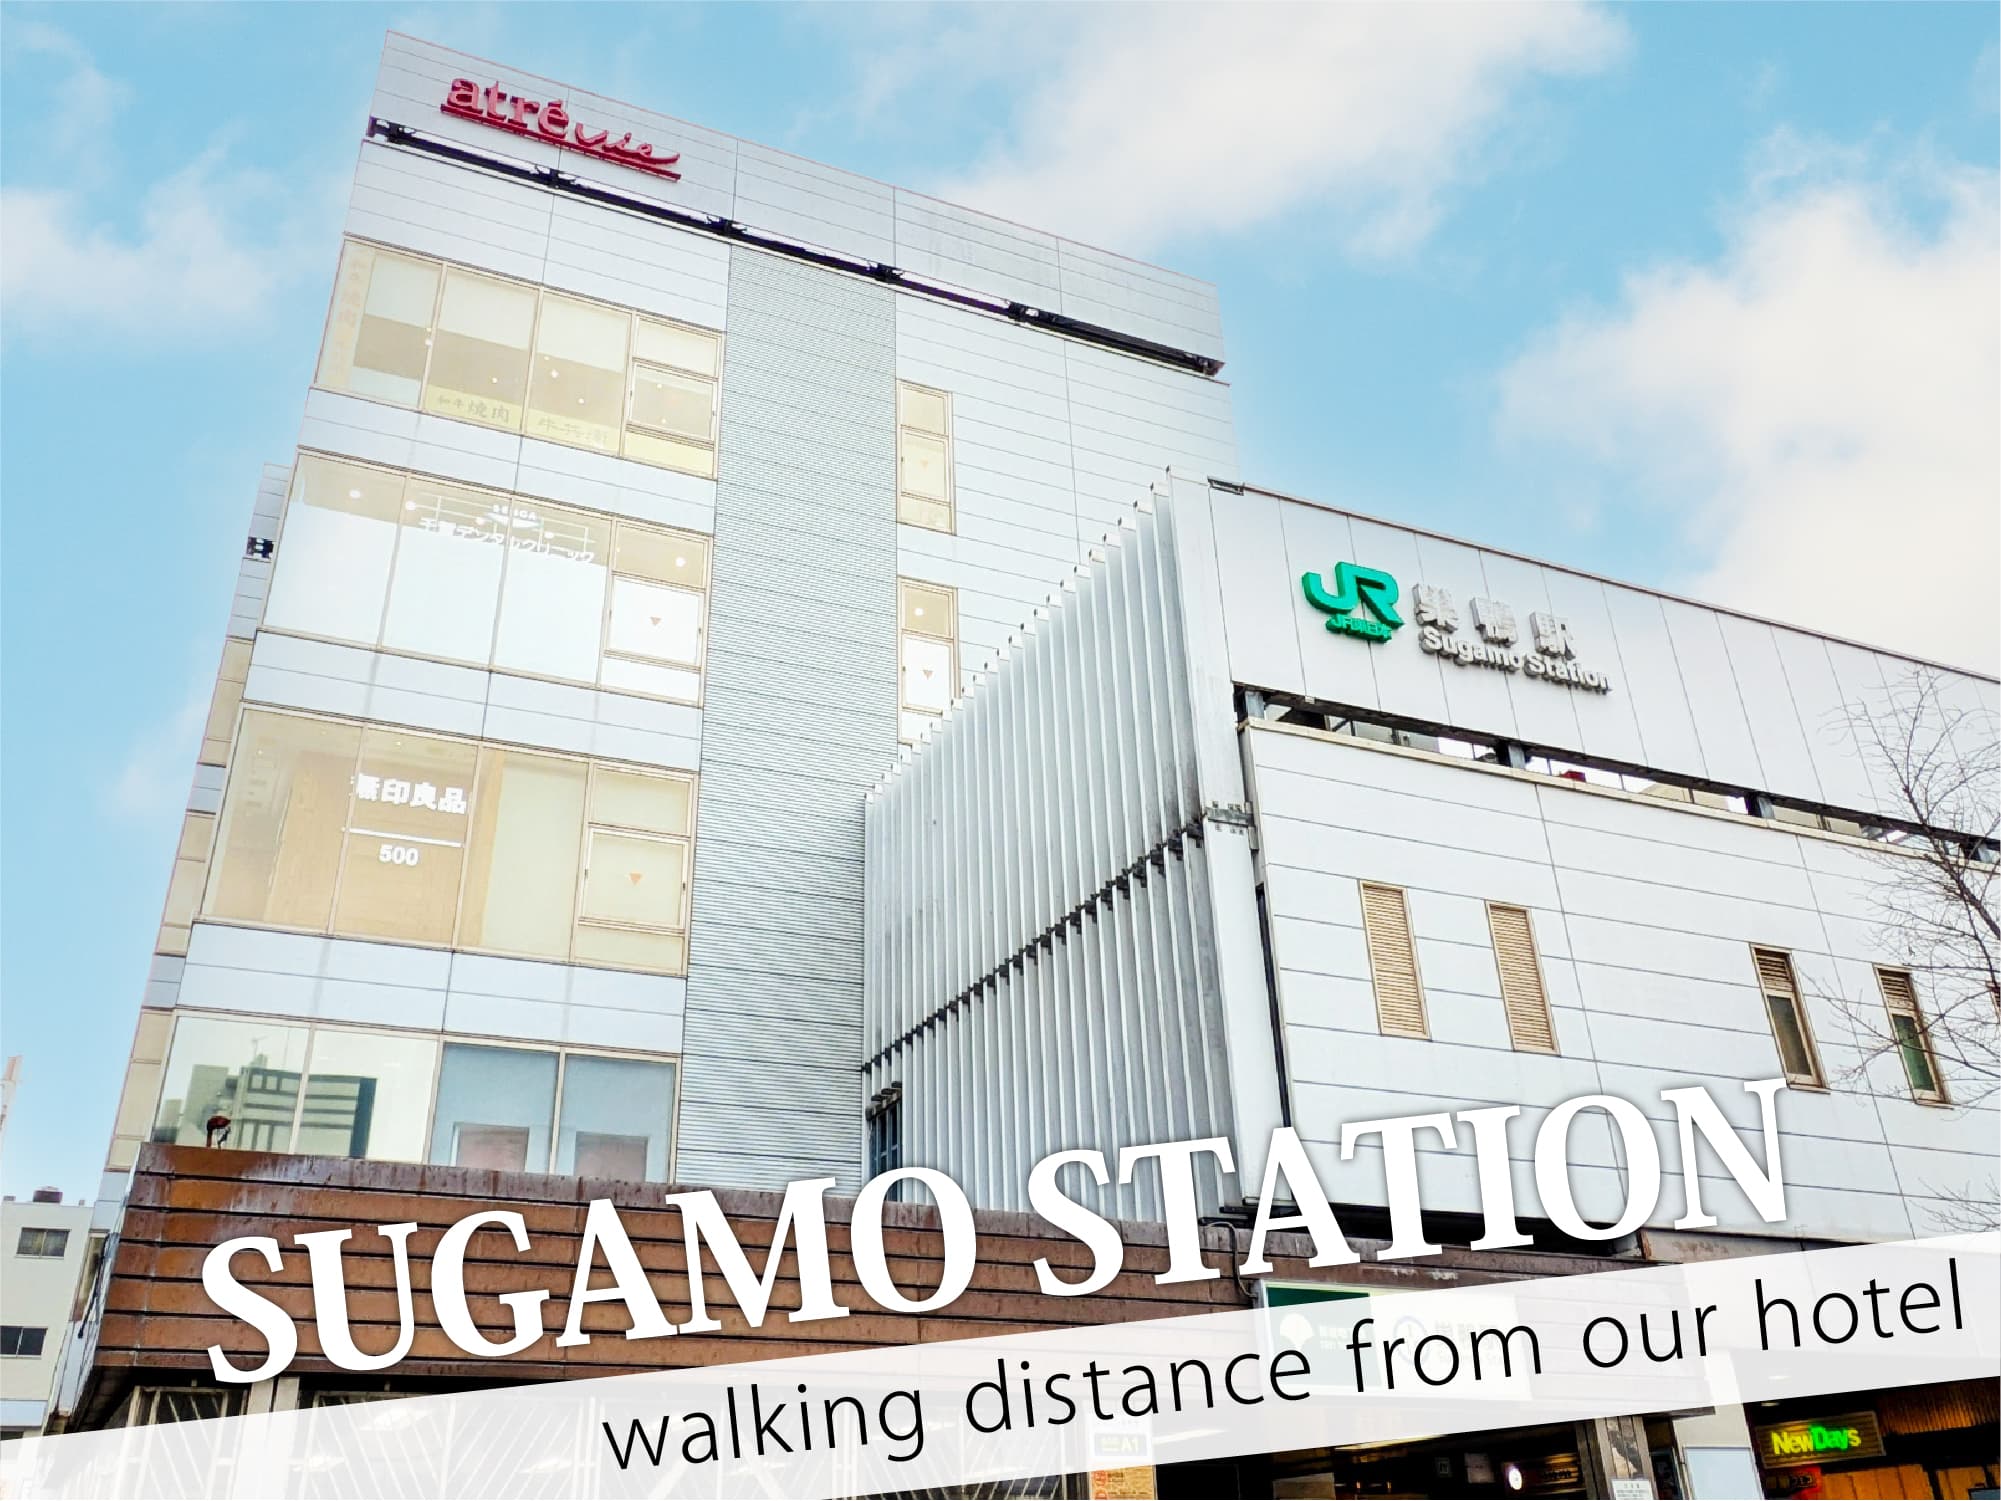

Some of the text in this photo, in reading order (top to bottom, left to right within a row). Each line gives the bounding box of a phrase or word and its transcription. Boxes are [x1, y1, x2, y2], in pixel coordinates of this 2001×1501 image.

[1302, 561, 1404, 629] JR
[1412, 583, 1577, 660] 巣鴨駅
[1419, 625, 1612, 695] Sugamo Station
[379, 843, 418, 866] 500
[1770, 1424, 1862, 1455] NewDays
